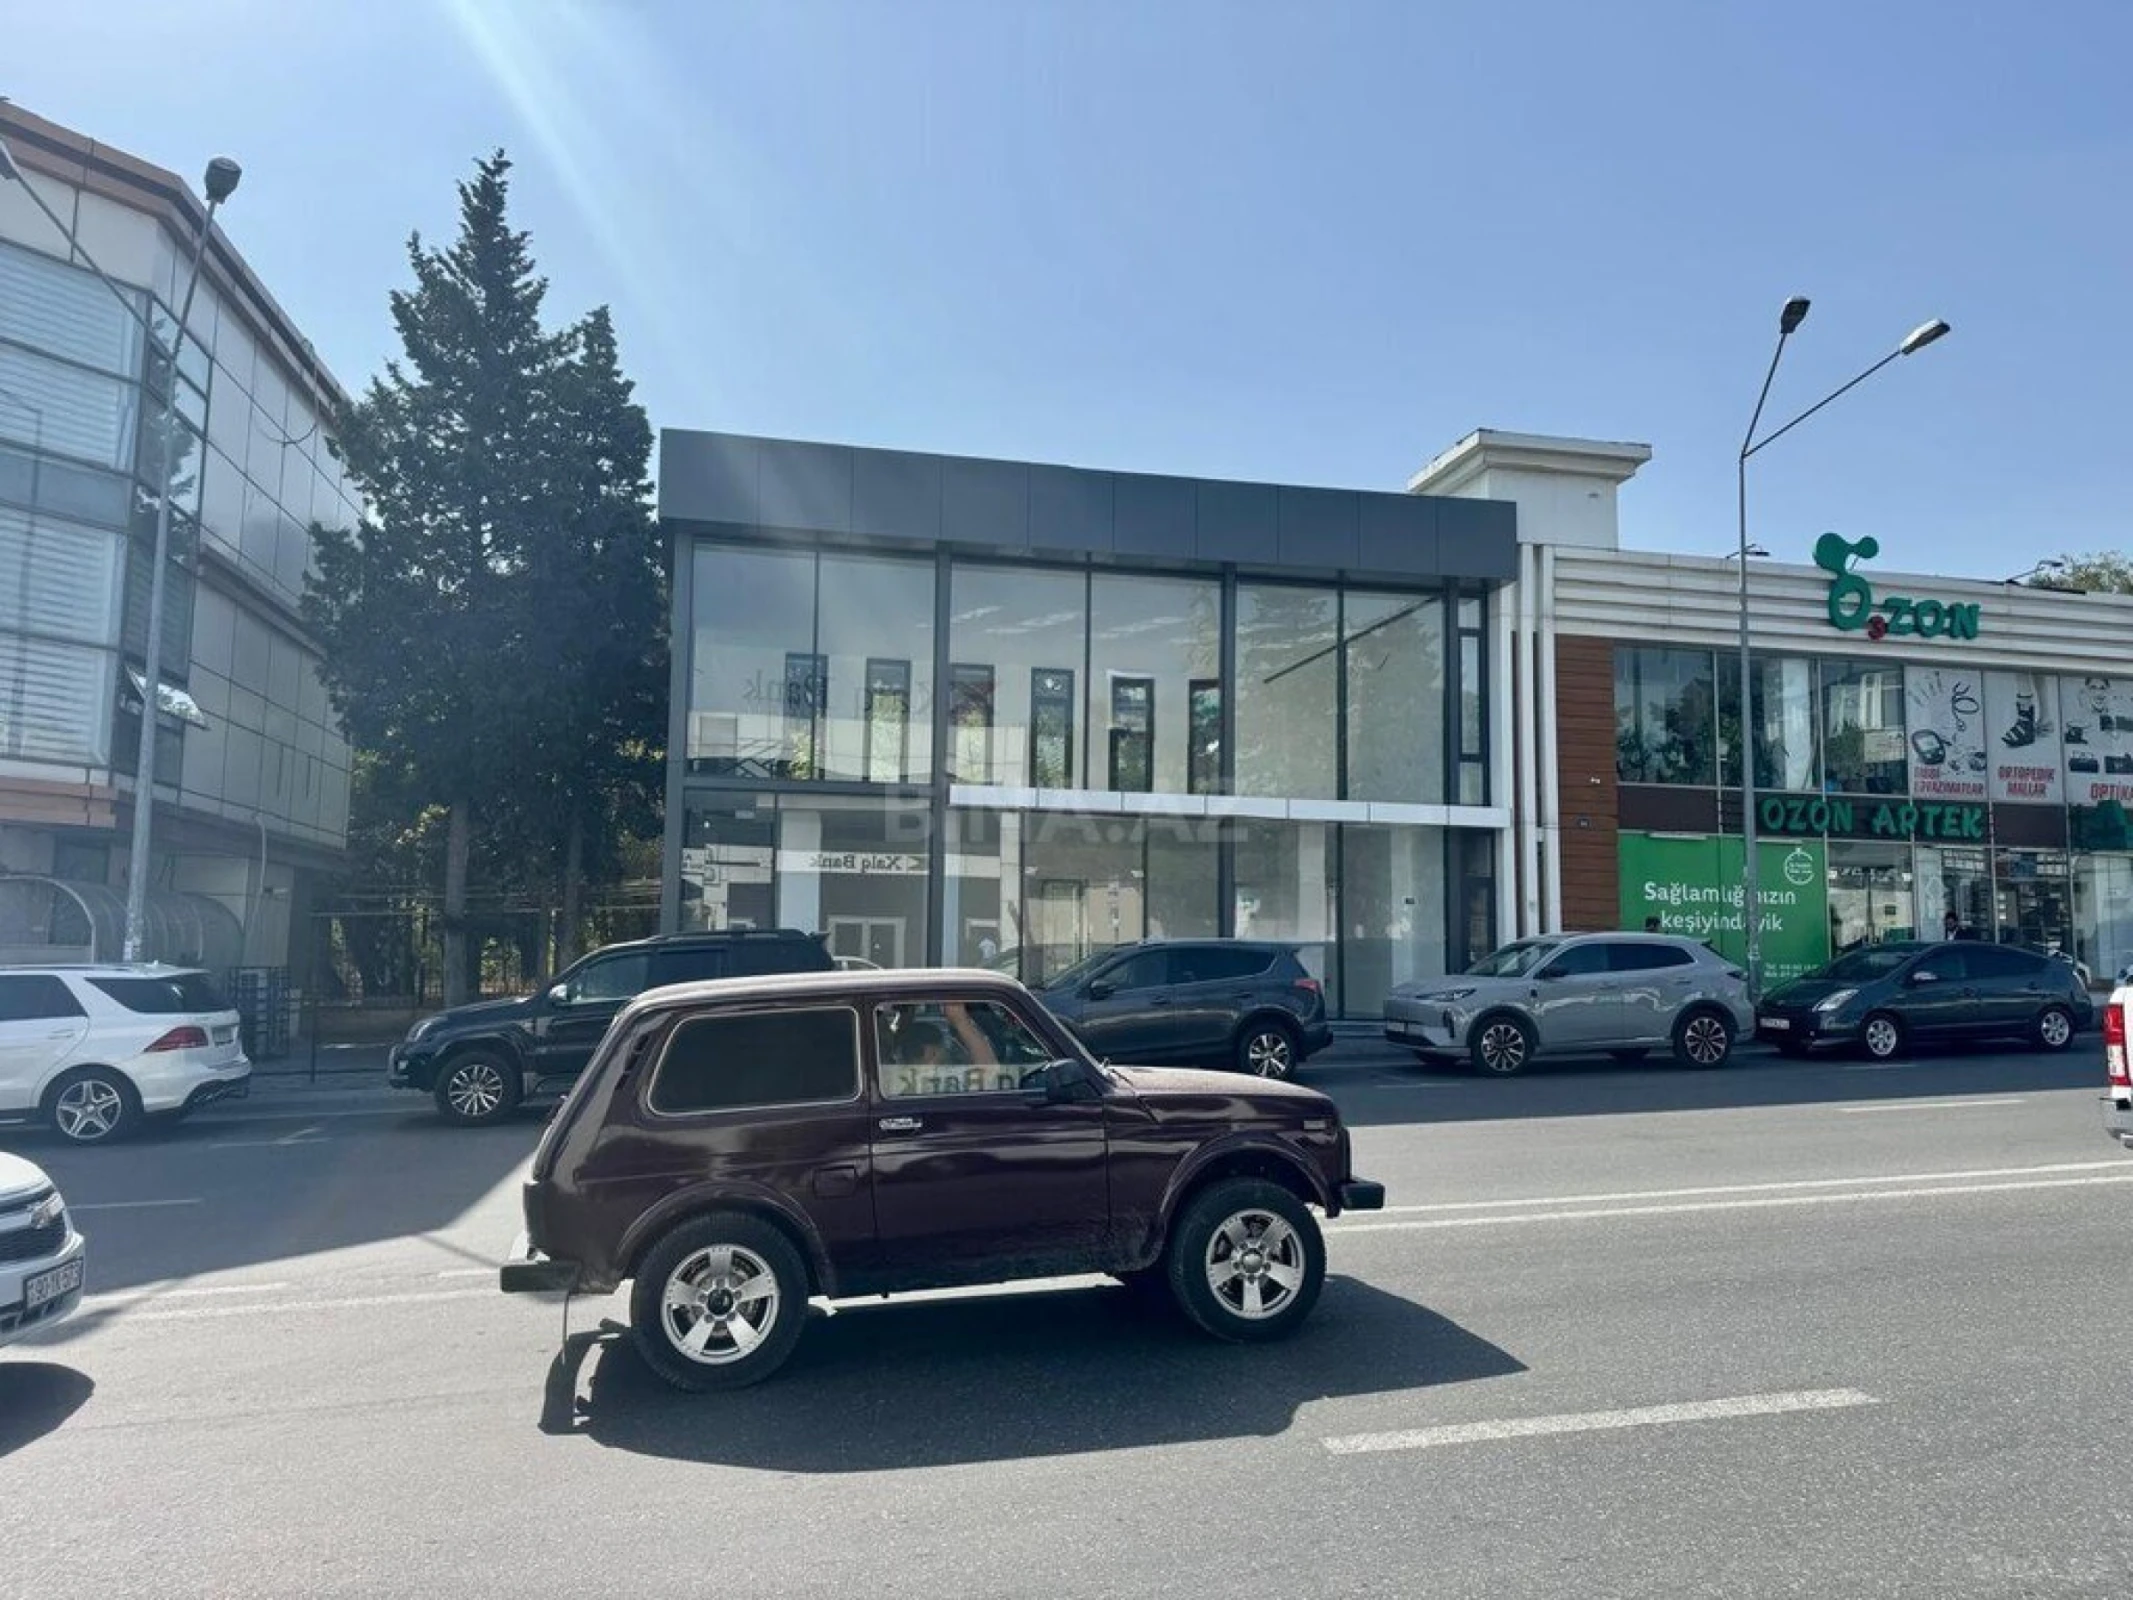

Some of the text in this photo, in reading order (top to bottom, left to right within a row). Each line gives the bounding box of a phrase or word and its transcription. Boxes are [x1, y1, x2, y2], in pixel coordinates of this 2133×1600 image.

[1762, 799, 1852, 833] OZON
[1643, 881, 1796, 908] Sağlamlığızın
[1661, 909, 1784, 935] keşiyindyik
